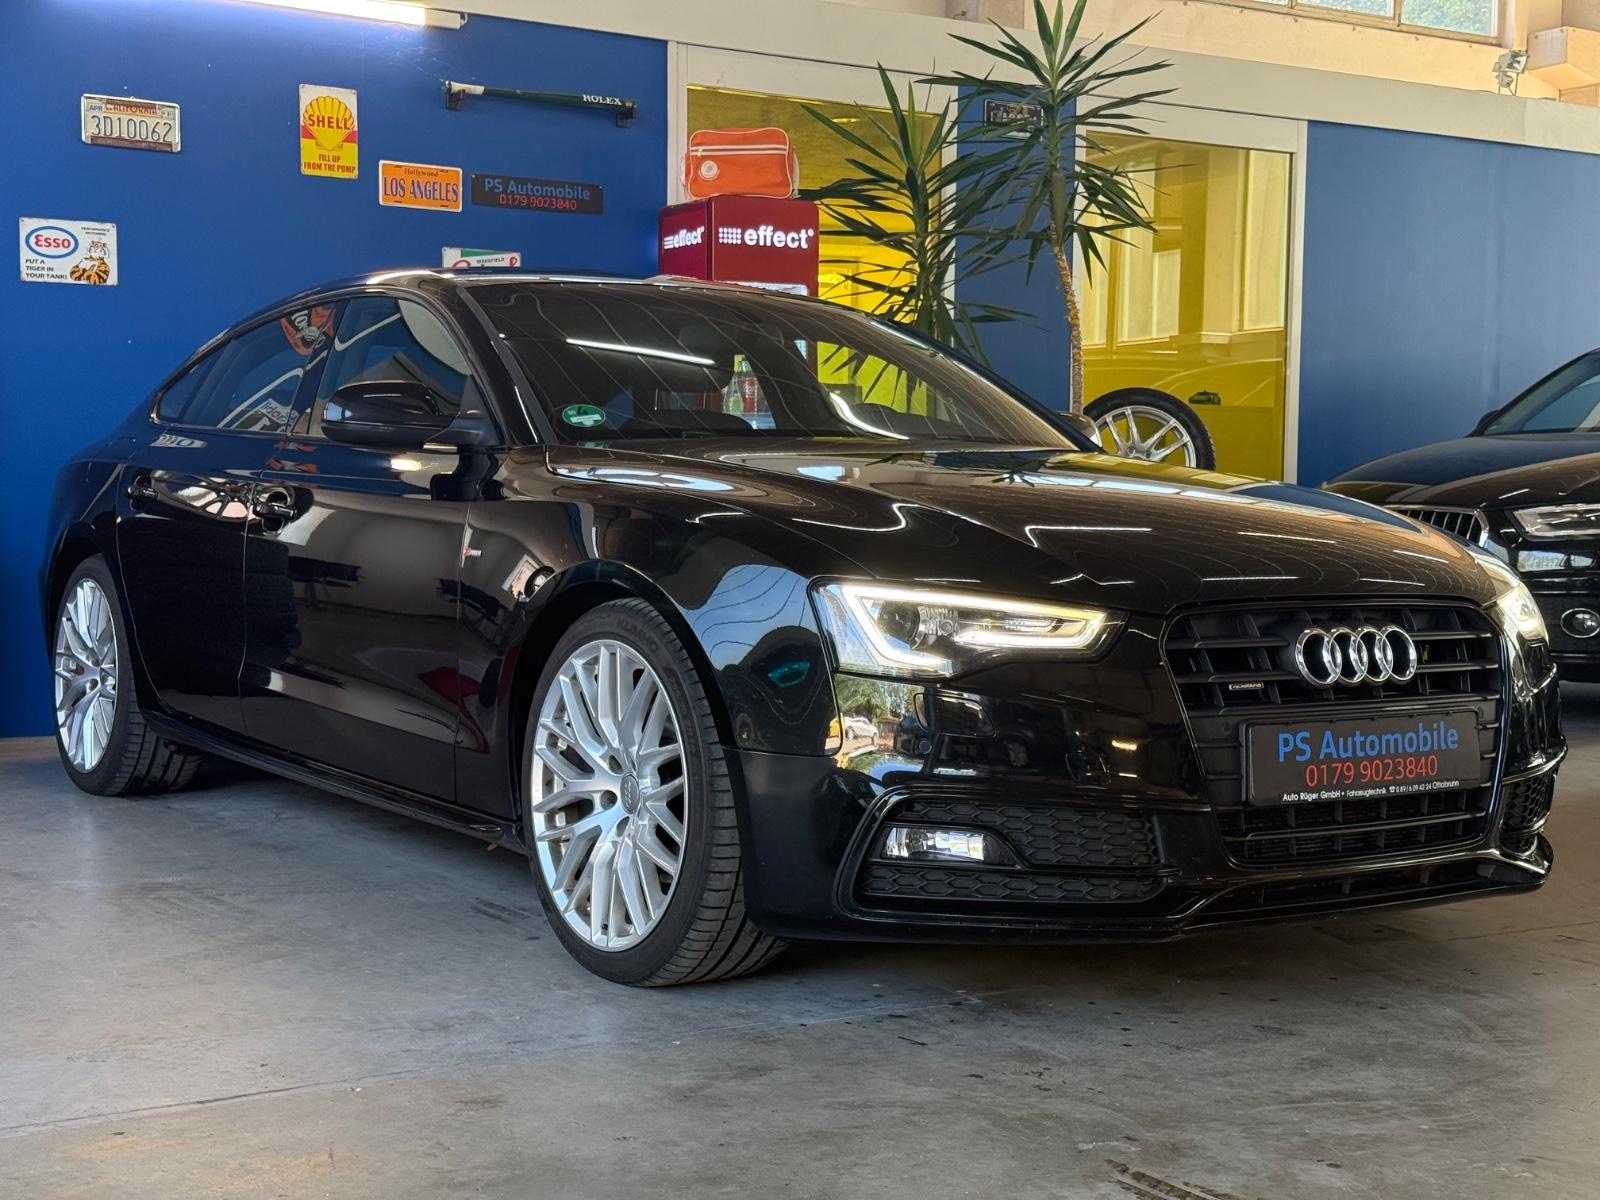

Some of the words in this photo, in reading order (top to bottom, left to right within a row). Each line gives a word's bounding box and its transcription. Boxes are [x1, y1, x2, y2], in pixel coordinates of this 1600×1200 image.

[582, 94, 622, 106] ROLEX
[91, 115, 172, 142] 3D10062
[307, 113, 351, 130] SHELL
[303, 161, 322, 171] FROM
[323, 163, 336, 172] THE
[336, 164, 356, 174] PUMP
[318, 153, 331, 163] FILL
[332, 155, 342, 164] UP
[404, 168, 439, 177] Hollywood
[383, 177, 406, 199] LOS
[409, 179, 459, 203] ANGELES
[484, 178, 503, 193] PS
[507, 180, 591, 200] Automobile
[499, 194, 528, 206] 0179
[530, 196, 577, 211] 9023840
[743, 224, 809, 249] effect
[1278, 731, 1312, 763] PS
[1319, 721, 1459, 760] Automobile
[1305, 762, 1355, 788] 0179
[1360, 755, 1438, 783] 9023840
[1282, 793, 1299, 802] Auto
[1300, 791, 1319, 802] Rüger
[1320, 789, 1341, 799] GmbH
[1432, 780, 1460, 789] Ottobrunn
